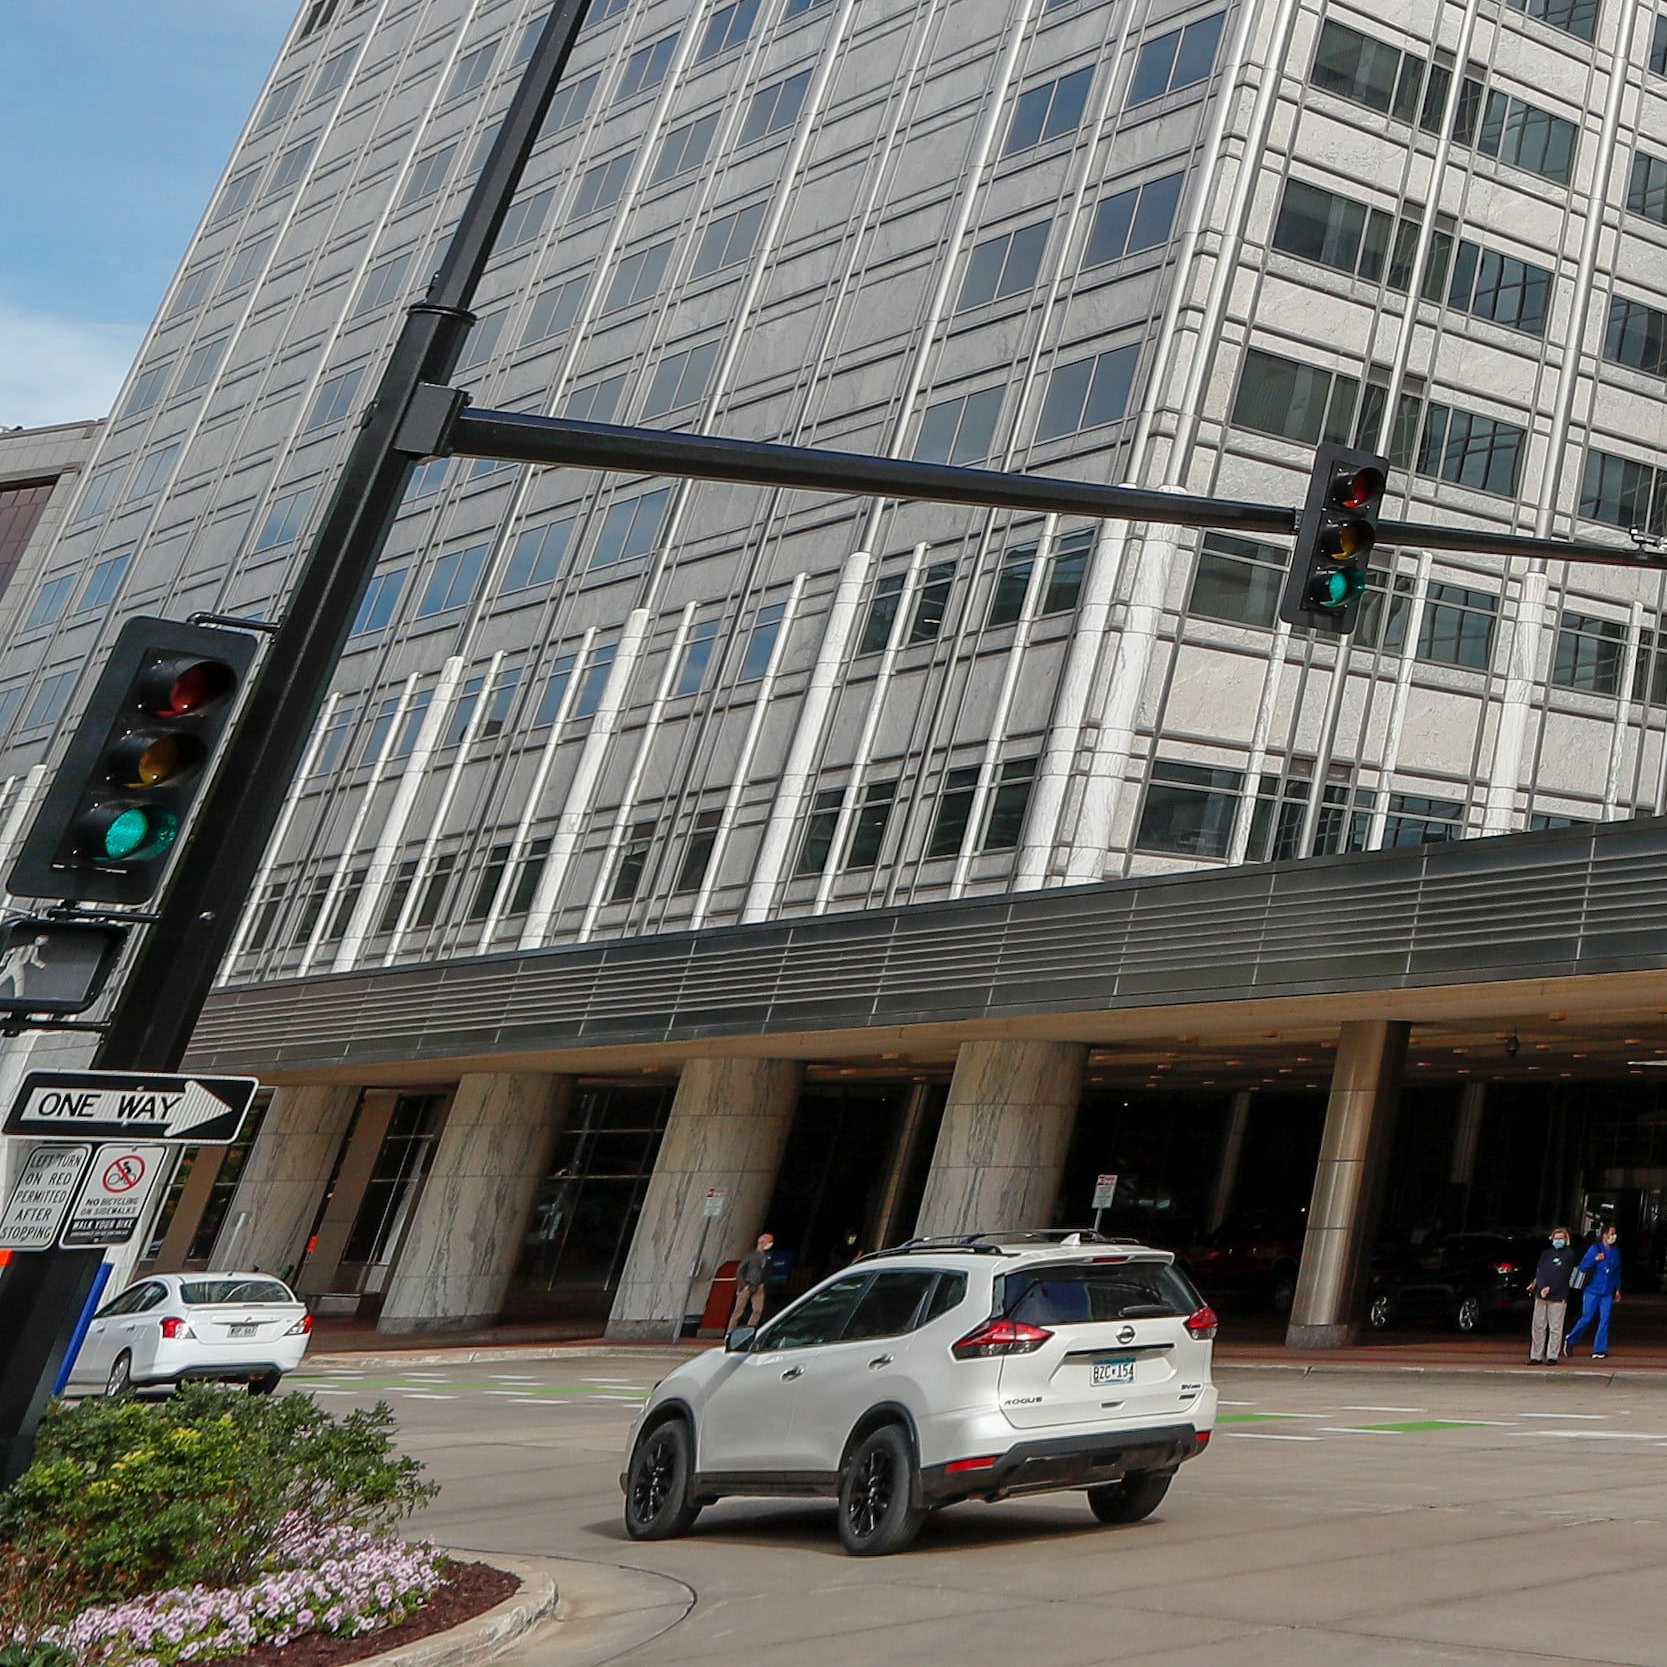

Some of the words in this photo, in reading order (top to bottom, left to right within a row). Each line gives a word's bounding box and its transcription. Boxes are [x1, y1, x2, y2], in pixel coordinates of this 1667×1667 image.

[38, 1093, 103, 1117] ONE
[117, 1095, 183, 1120] WAY
[30, 1155, 55, 1168] LEFT
[56, 1154, 83, 1168] TURN
[26, 1173, 43, 1185] ON
[48, 1173, 72, 1185] RED
[15, 1190, 67, 1204] PERMITTED
[85, 1198, 100, 1206] NO
[15, 1208, 52, 1222] AFTER
[72, 1220, 95, 1231] WALK
[0, 1226, 53, 1240] STOPPING
